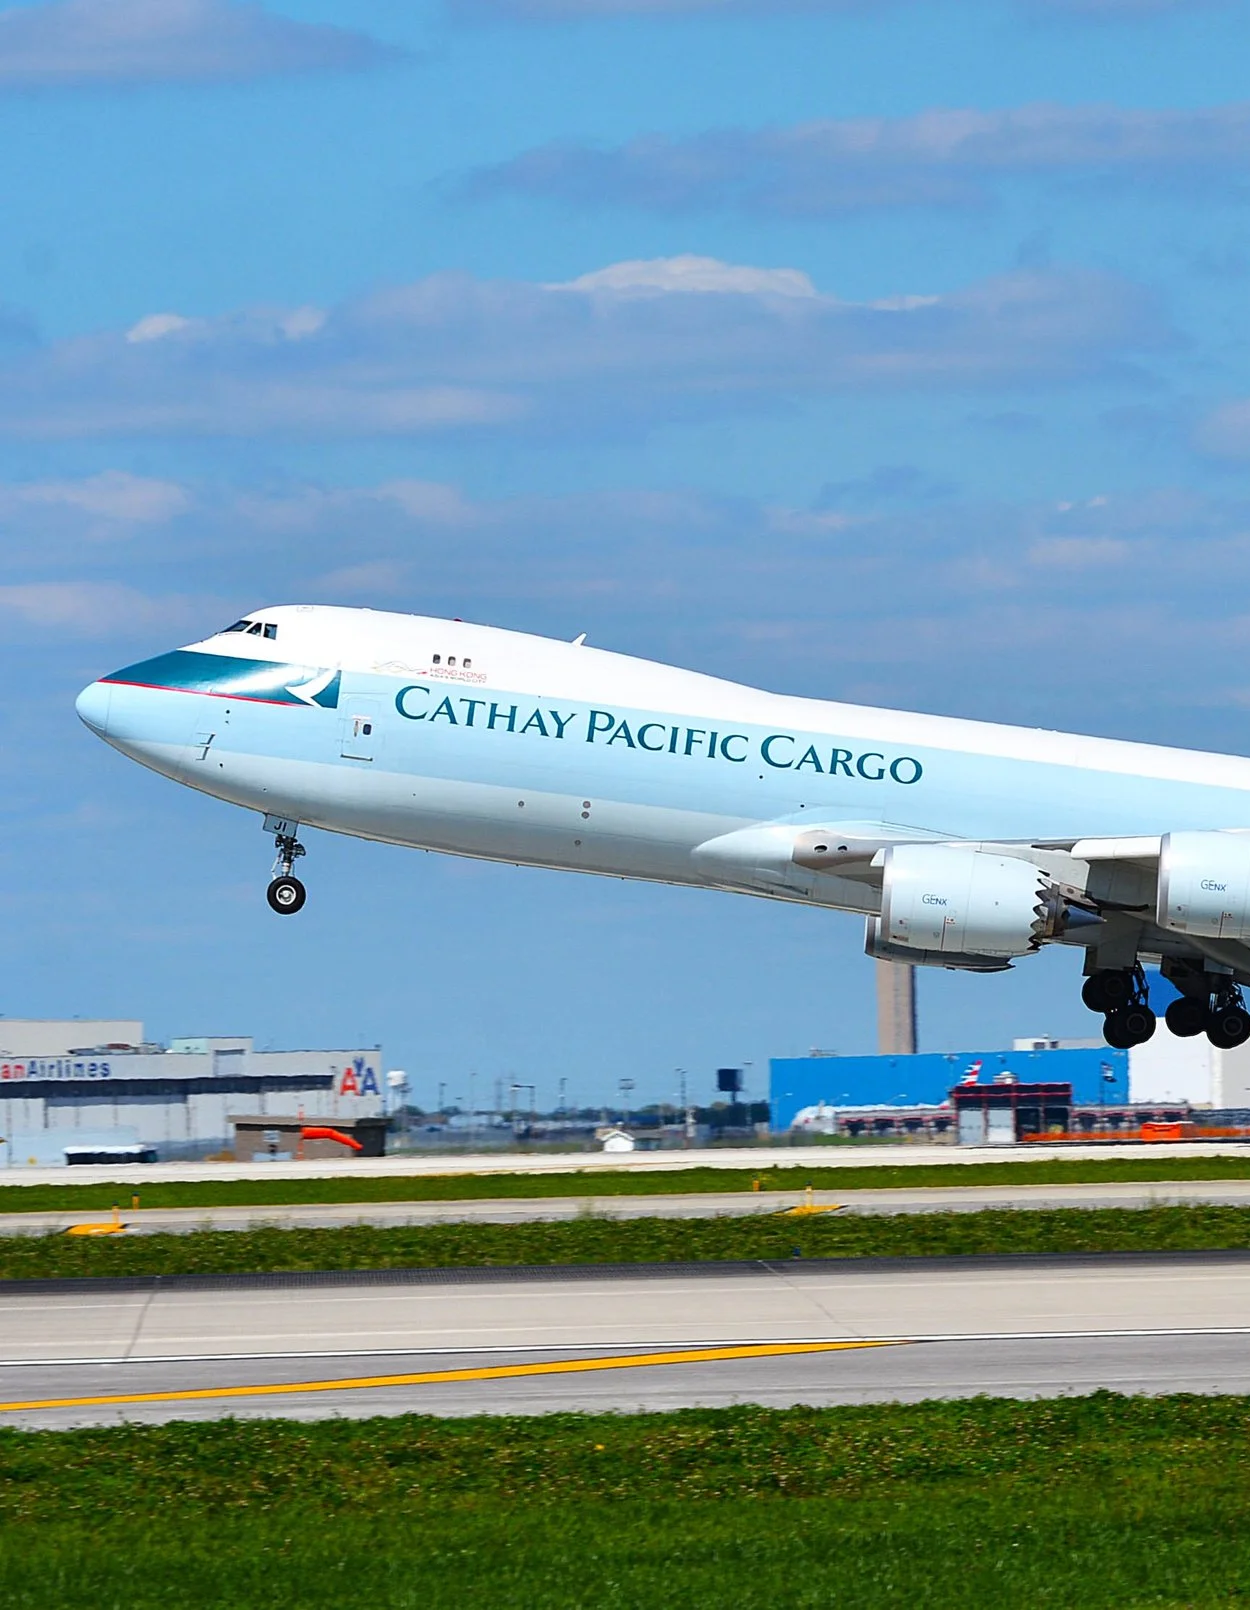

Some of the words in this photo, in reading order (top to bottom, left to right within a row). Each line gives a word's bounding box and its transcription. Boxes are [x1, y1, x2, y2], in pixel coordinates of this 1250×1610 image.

[430, 668, 458, 676] HONG
[460, 671, 487, 680] KONG
[395, 685, 577, 739] CATHAY
[585, 710, 749, 762] PACIFIC
[760, 735, 923, 784] CARGO
